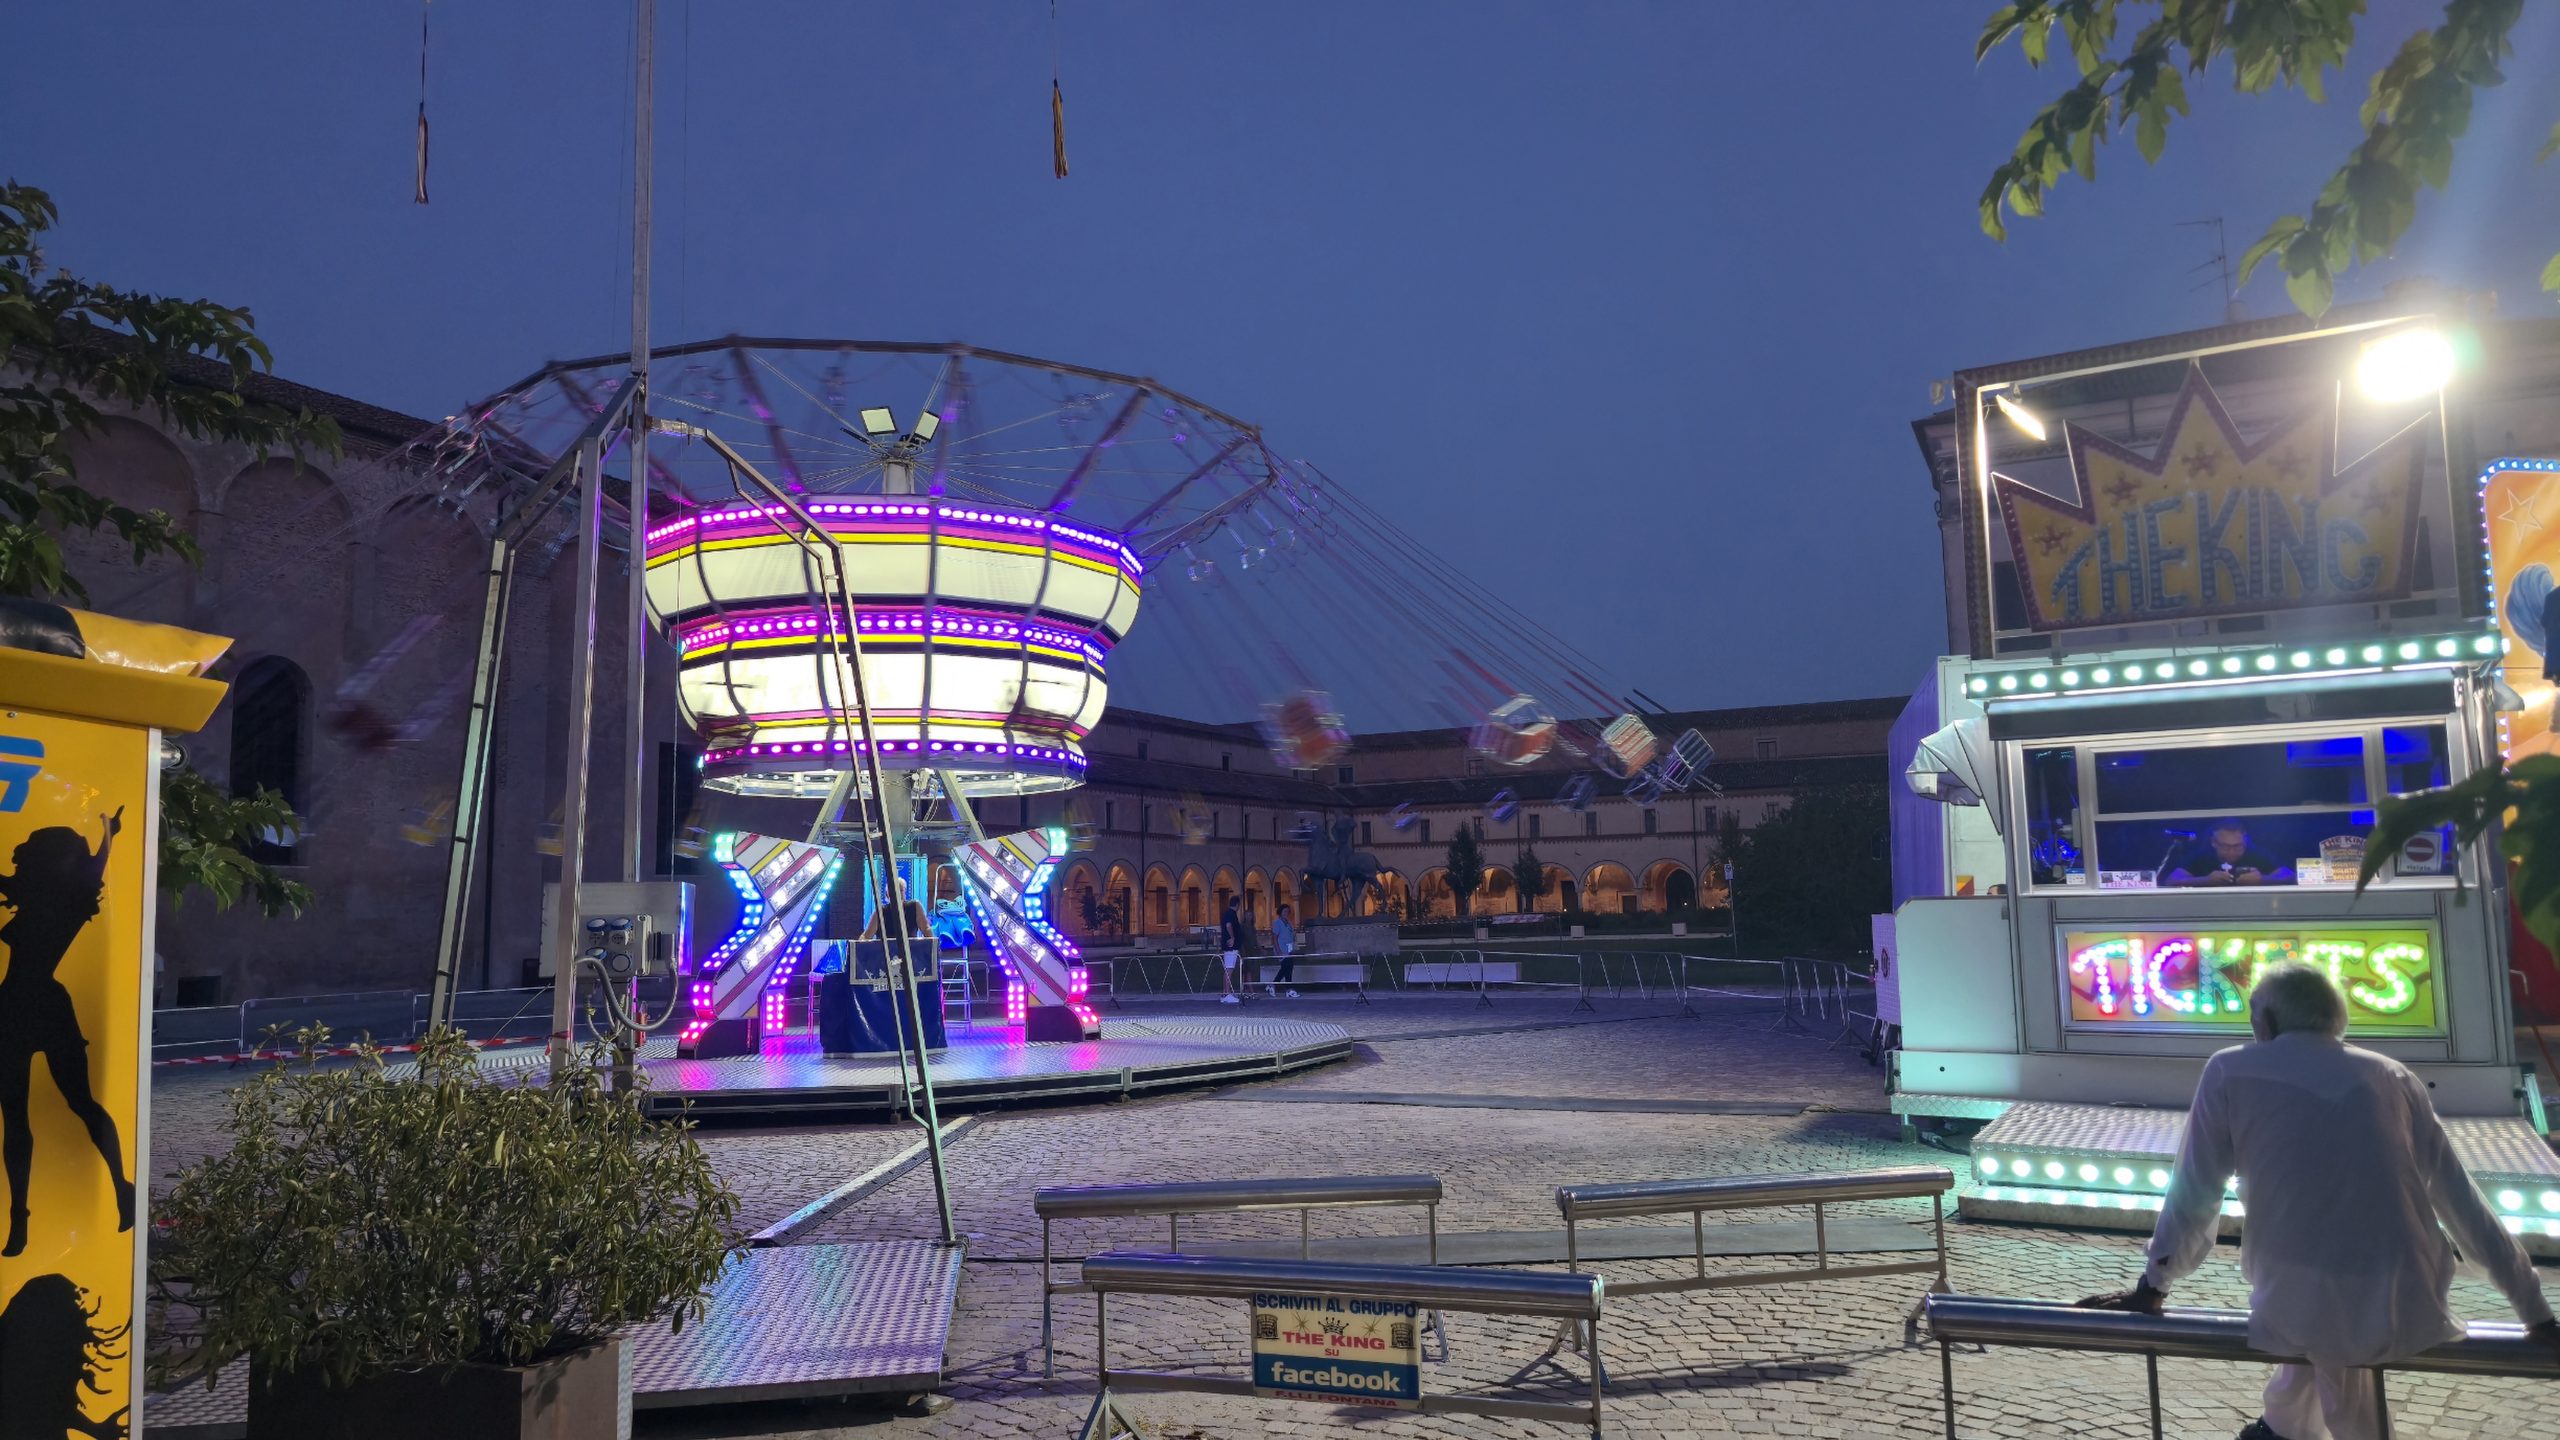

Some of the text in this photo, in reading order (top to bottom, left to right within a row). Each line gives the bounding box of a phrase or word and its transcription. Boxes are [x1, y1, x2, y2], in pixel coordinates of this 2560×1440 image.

[2051, 486, 2383, 618] THE KING
[1252, 1293, 1416, 1318] ISCRIVITI AL GRUPPO
[1282, 1331, 1385, 1350] THE KING
[1324, 1348, 1340, 1356] SU
[1271, 1361, 1400, 1392] facebook
[1275, 1390, 1398, 1407] F.LLI FONTANA
